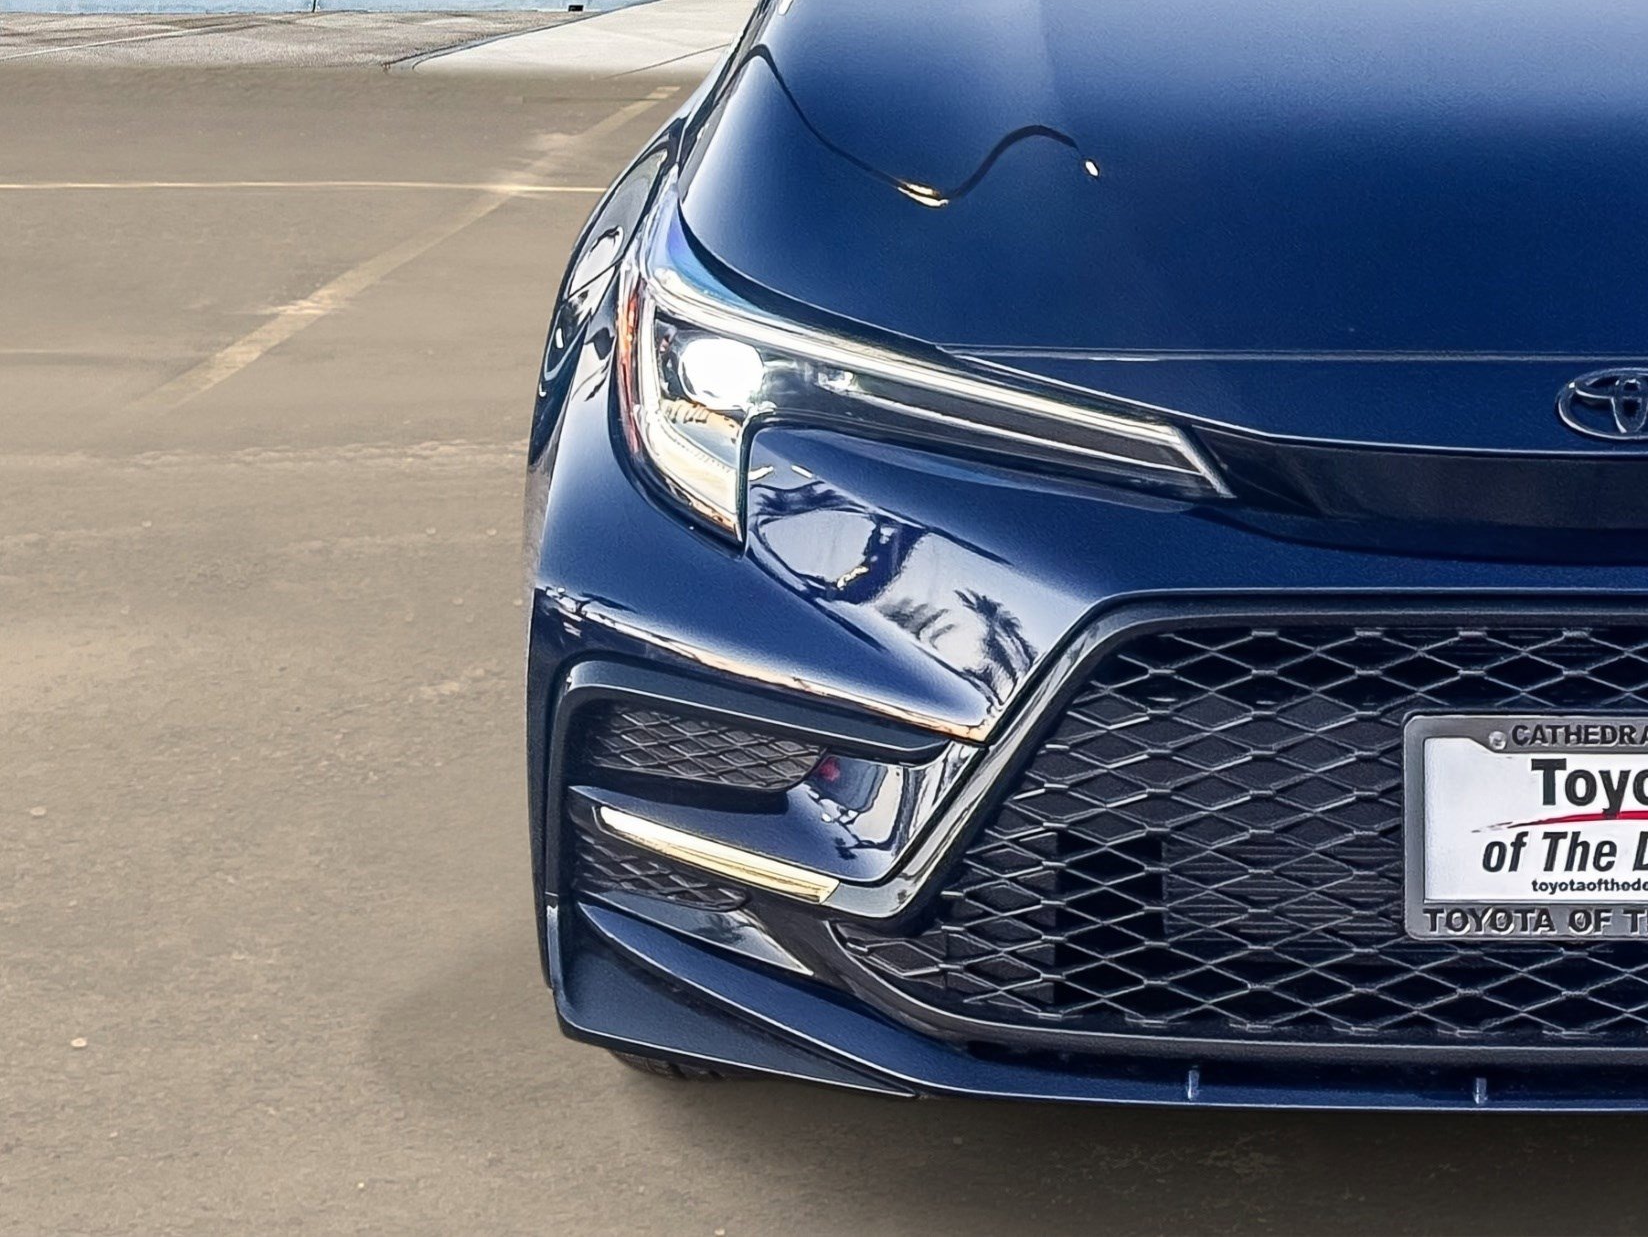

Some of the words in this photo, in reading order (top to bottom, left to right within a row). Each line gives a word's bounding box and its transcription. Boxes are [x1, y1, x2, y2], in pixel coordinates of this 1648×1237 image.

[1482, 831, 1529, 872] of
[1541, 831, 1618, 872] The
[1424, 908, 1554, 934] TOYOTA
[1568, 909, 1611, 934] OF
